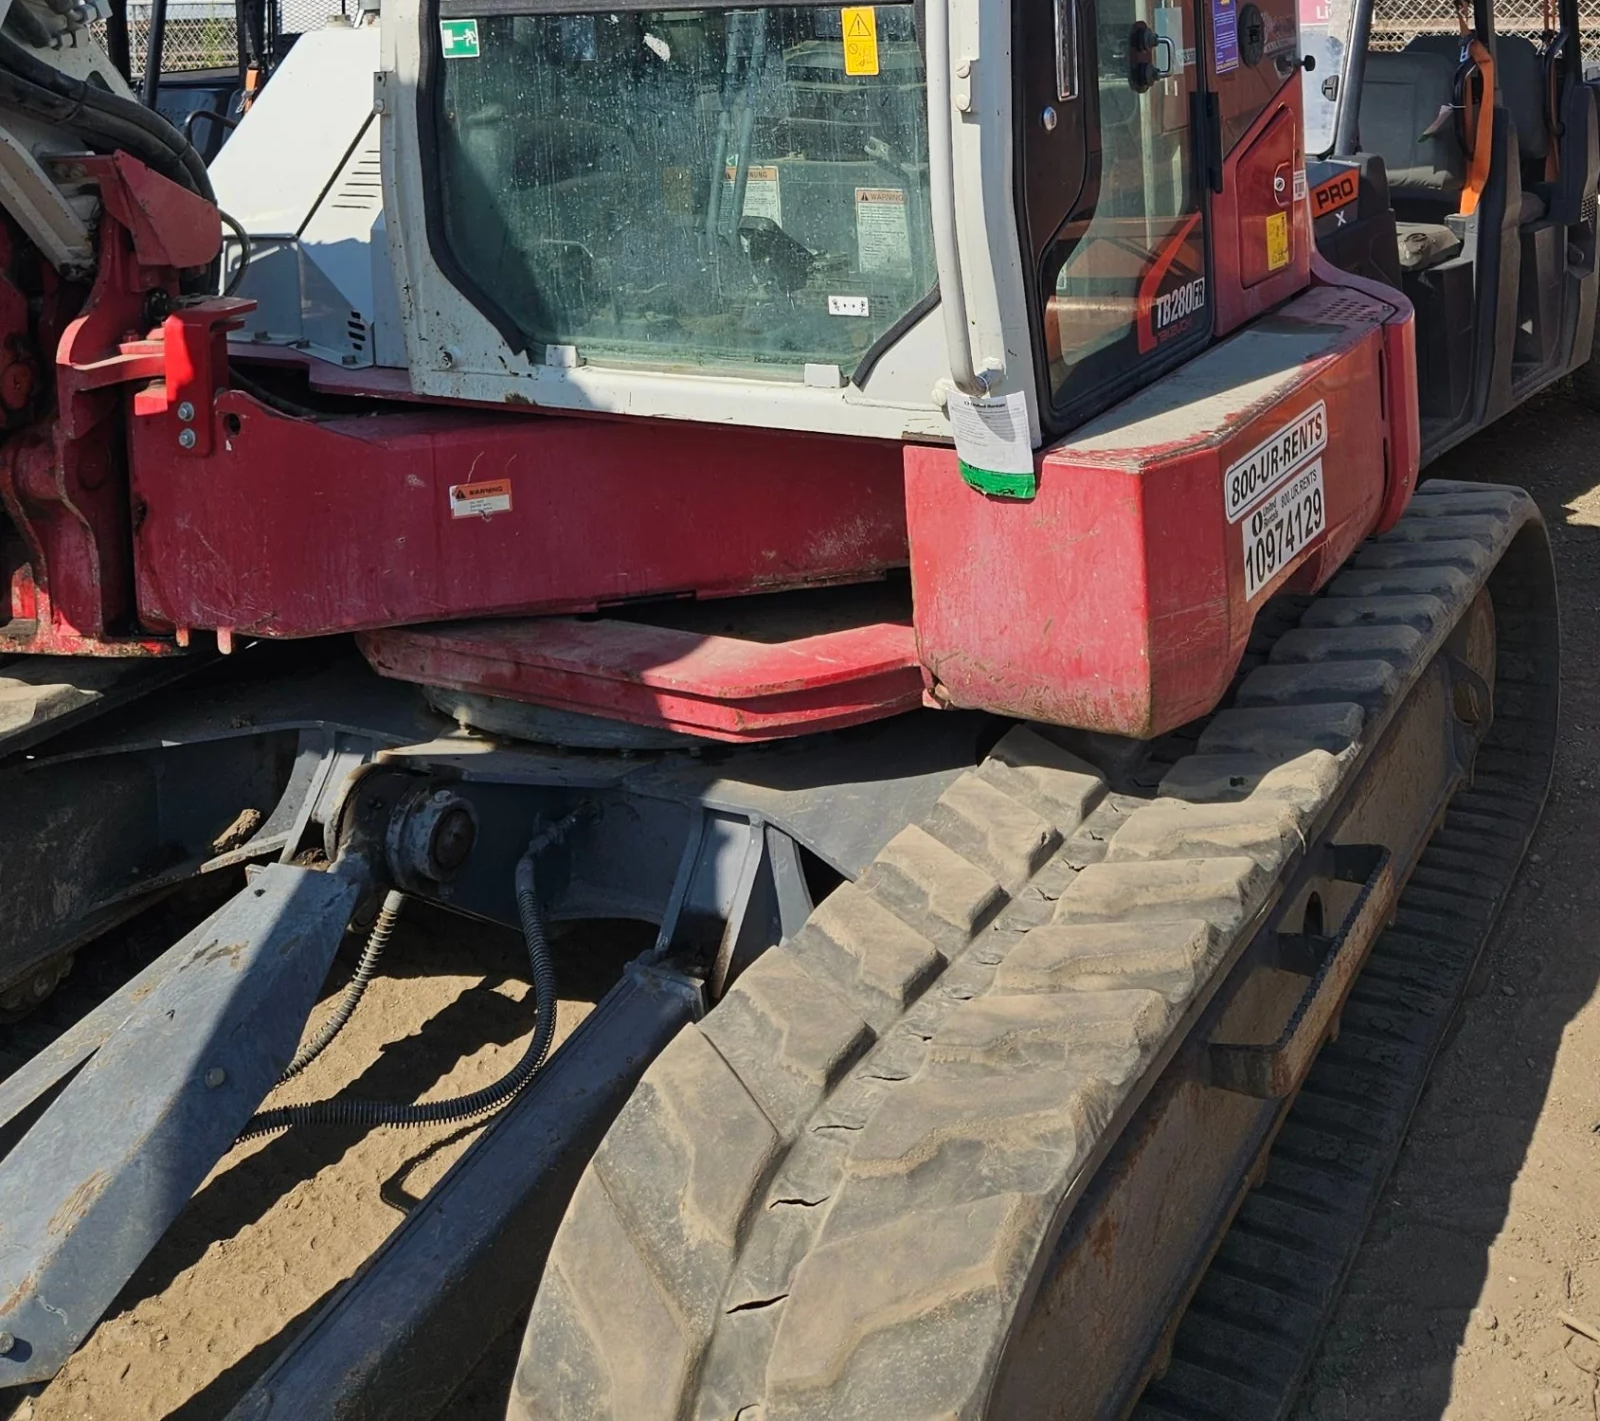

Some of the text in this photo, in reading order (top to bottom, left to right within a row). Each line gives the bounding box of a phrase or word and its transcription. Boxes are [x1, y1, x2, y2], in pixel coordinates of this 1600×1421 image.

[870, 193, 904, 202] WARNING
[1316, 177, 1354, 209] PRO
[1335, 210, 1347, 227] X
[1232, 412, 1322, 507] 800-UR-RENTS
[1245, 487, 1322, 591] 10974129
